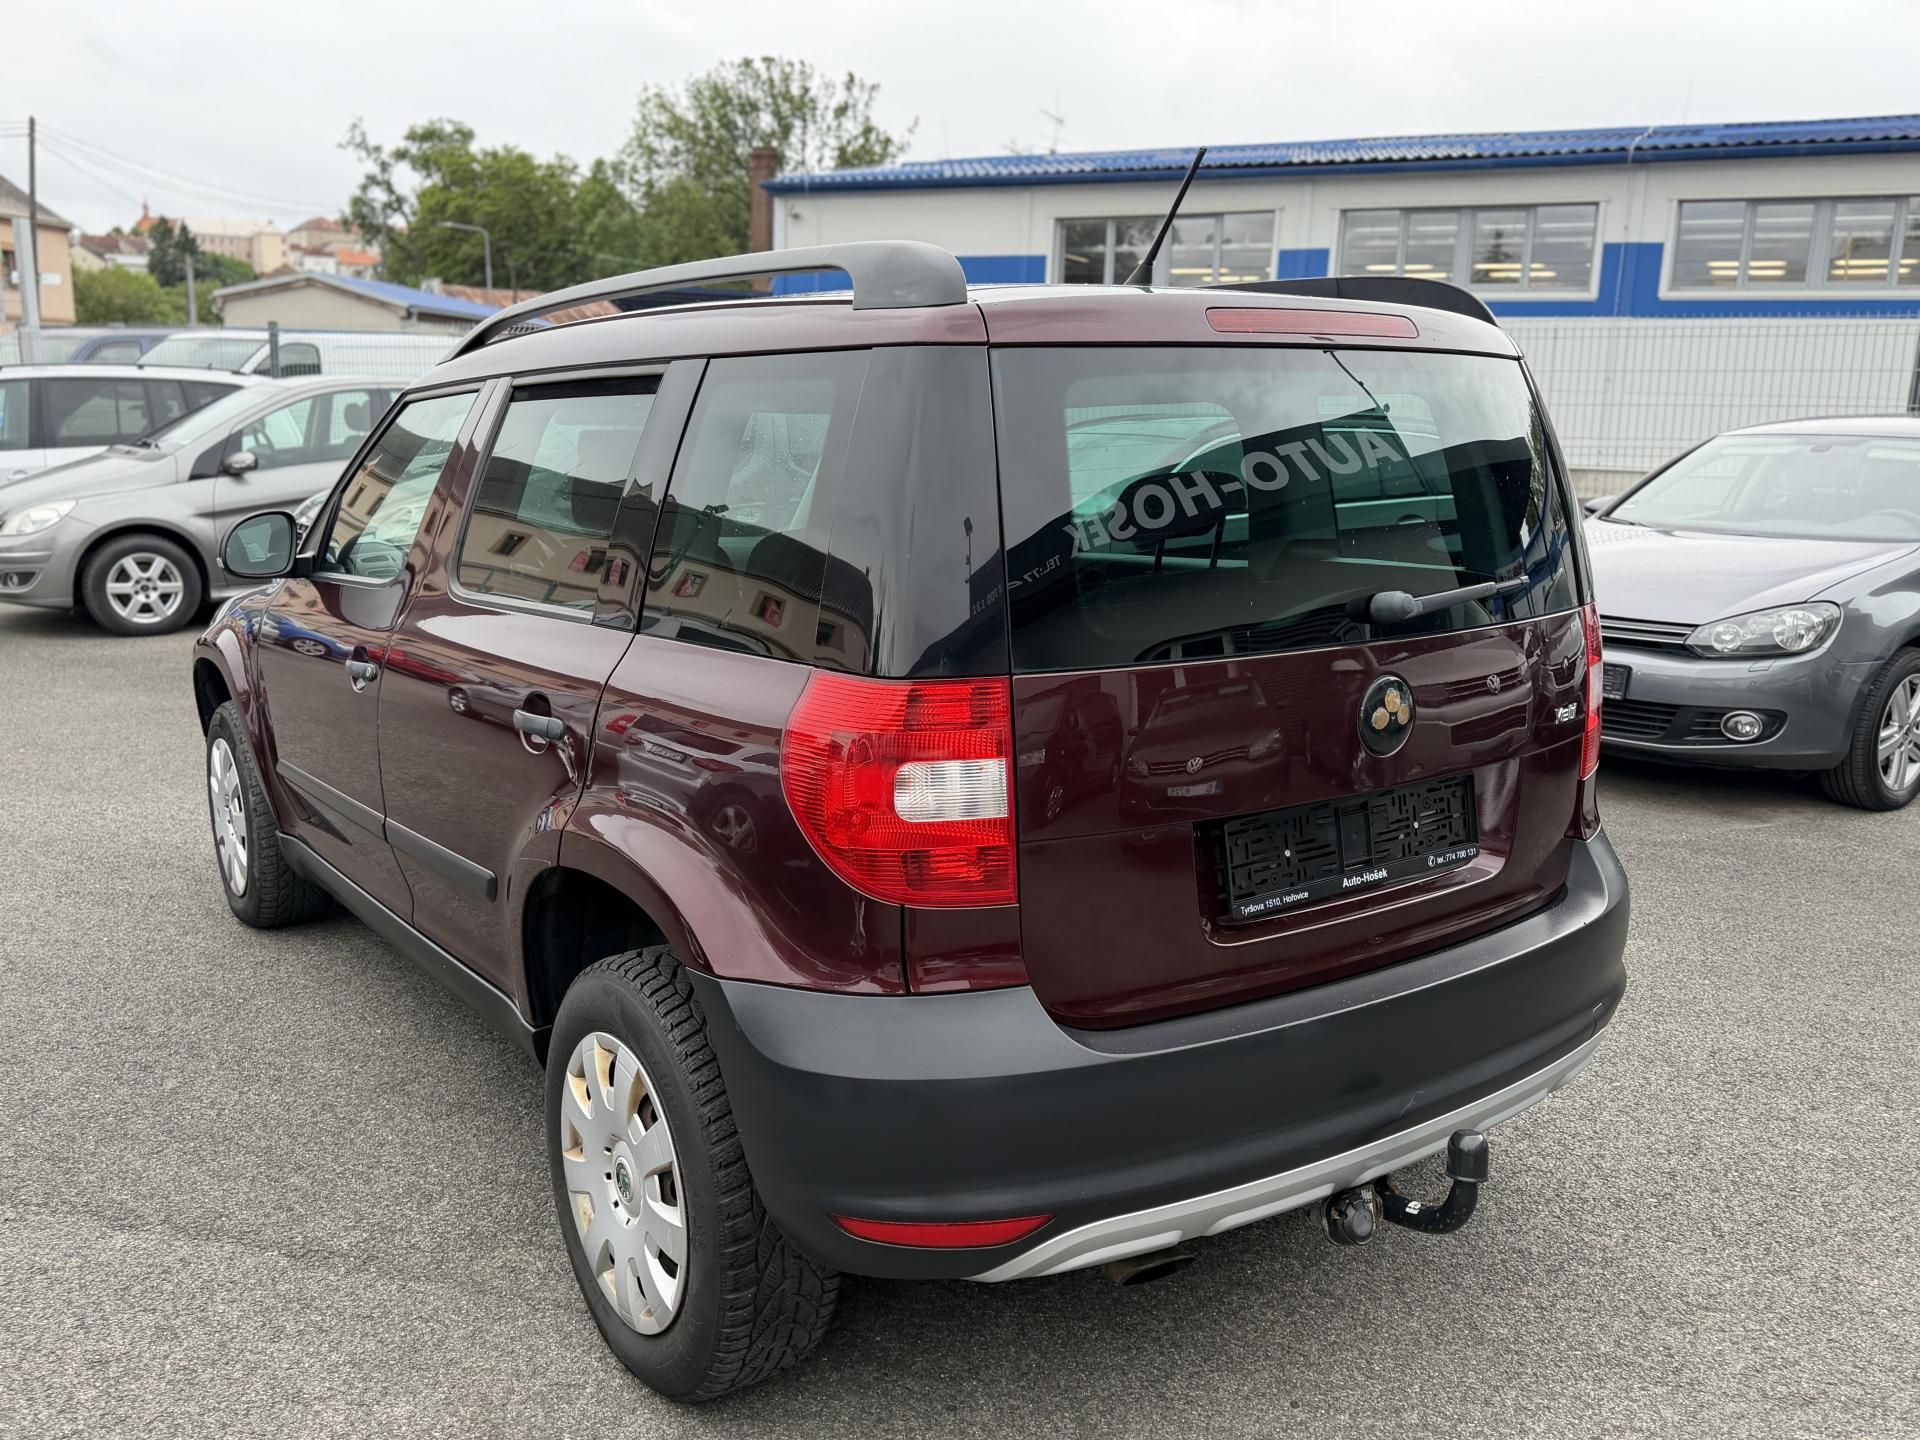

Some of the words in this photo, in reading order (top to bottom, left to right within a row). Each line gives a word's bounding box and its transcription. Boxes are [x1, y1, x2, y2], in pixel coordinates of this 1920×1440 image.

[1456, 850, 1467, 859] 700
[1467, 847, 1477, 857] 131
[1342, 868, 1388, 888] Auto-Hošek
[1240, 903, 1265, 917] Tyršova
[1265, 897, 1283, 908] 1510,
[1282, 891, 1309, 904] Hořovice
